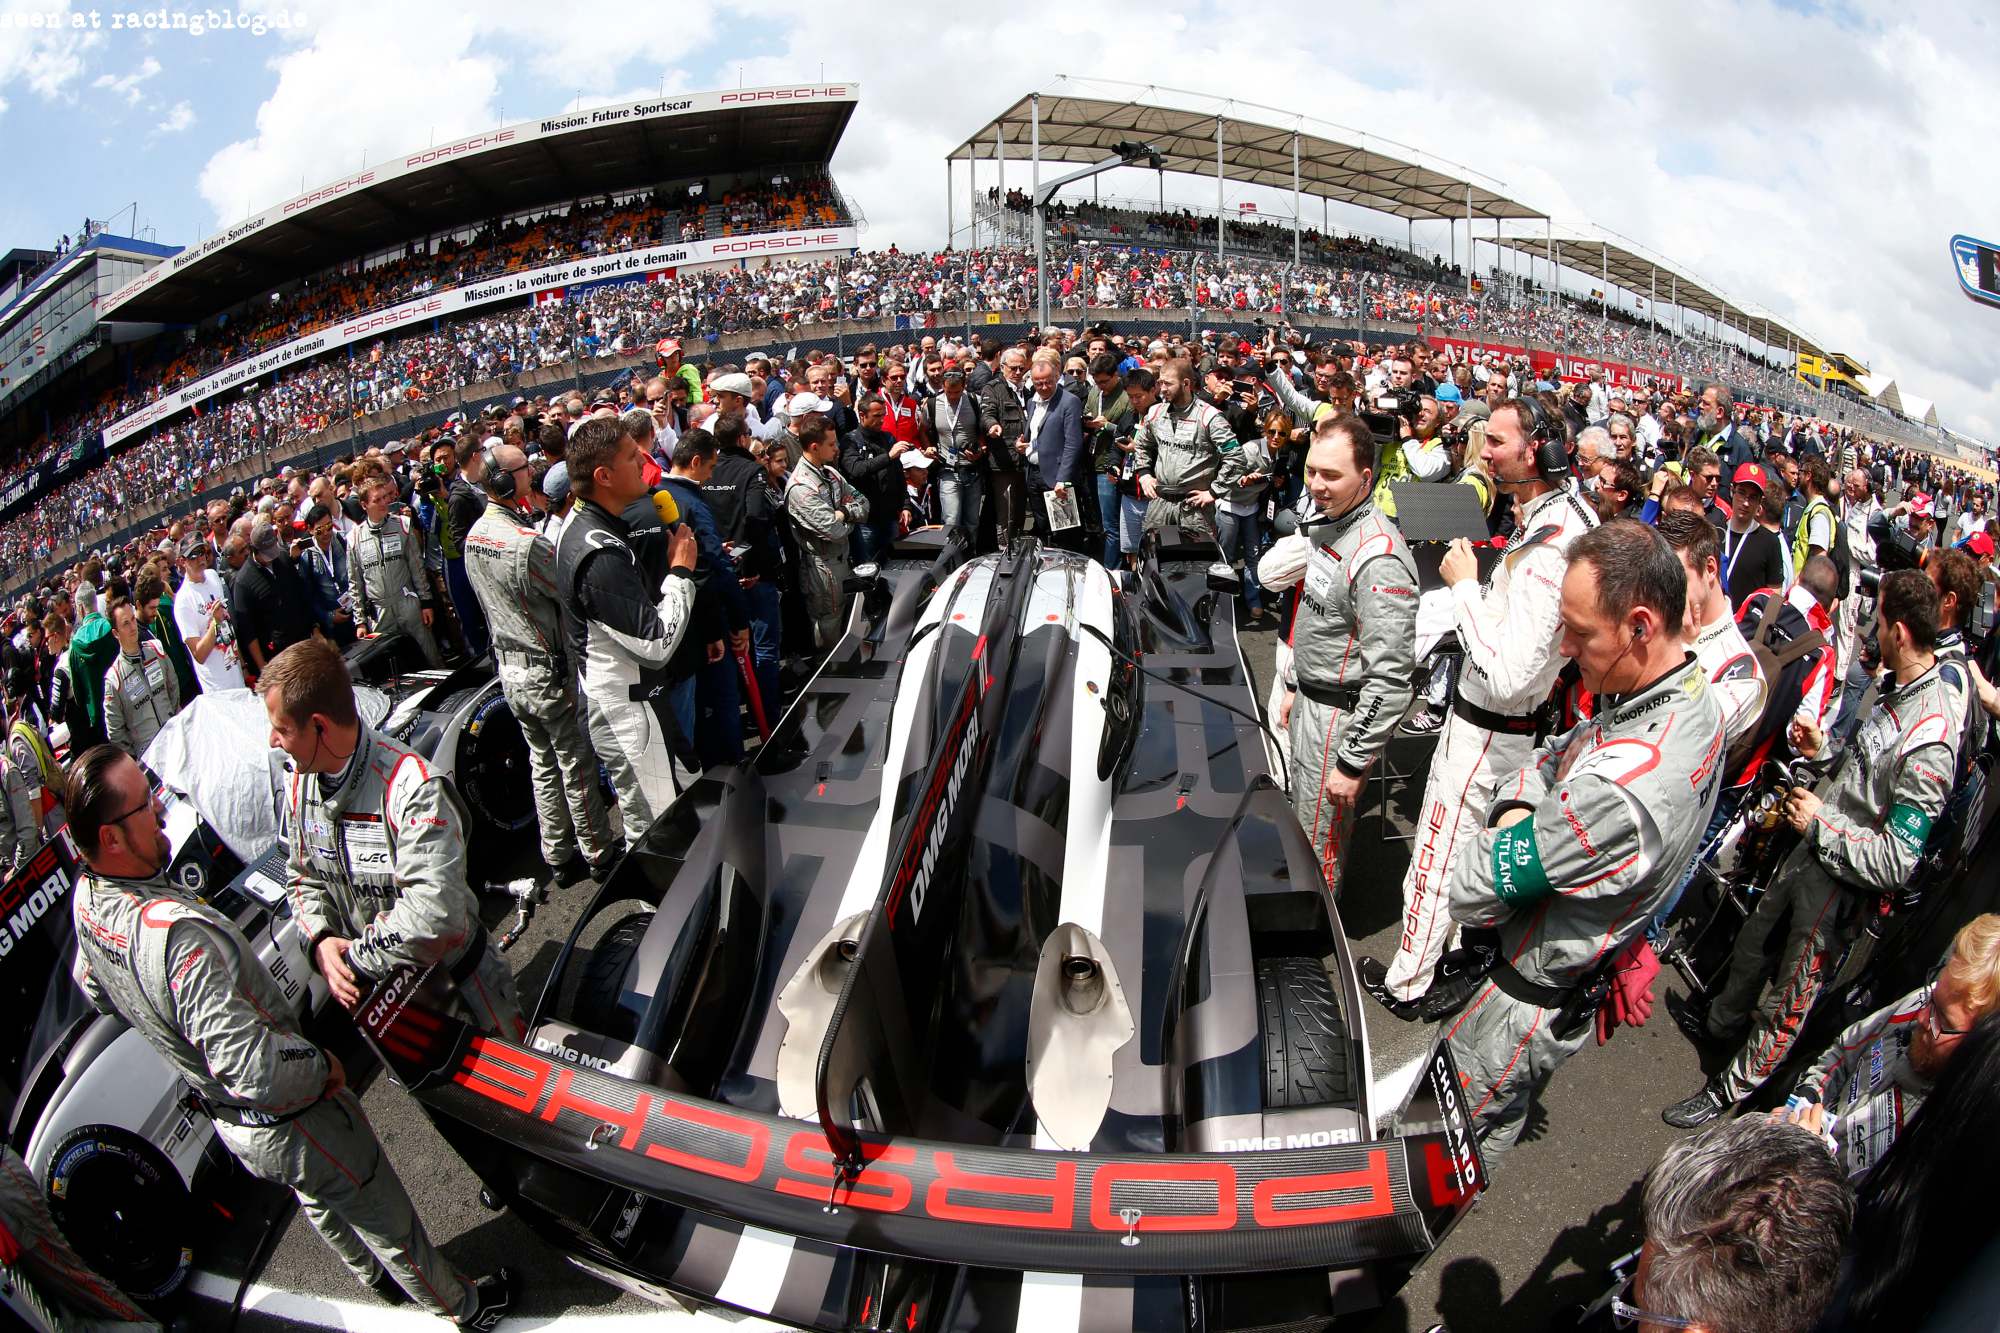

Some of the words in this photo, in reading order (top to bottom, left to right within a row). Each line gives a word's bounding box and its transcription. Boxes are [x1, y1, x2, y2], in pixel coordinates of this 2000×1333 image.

[720, 87, 847, 104] PORSCHE
[540, 116, 589, 133] Mission:
[592, 108, 631, 124] Future
[633, 99, 693, 118] Sportscar
[406, 129, 515, 168] PORSCHE
[283, 171, 375, 214] PORSCHE
[173, 249, 201, 269] Mission:
[203, 234, 226, 254] Future
[228, 217, 266, 240] Sportscar
[712, 233, 839, 254] PORSCHE
[101, 270, 160, 312] PORSCHE
[464, 286, 506, 303] Mission
[515, 278, 527, 291] la
[529, 270, 570, 288] voiture
[572, 267, 586, 278] de
[590, 262, 621, 277] sport
[625, 256, 640, 269] de
[643, 249, 687, 265] demain
[343, 300, 442, 337] PORSCHE
[180, 388, 206, 404] Mission
[211, 379, 220, 390] la
[220, 370, 246, 387] voiture
[247, 364, 258, 378] de
[258, 354, 280, 375] sport
[281, 348, 292, 361] de
[294, 337, 325, 357] demain
[1444, 343, 1513, 367] NISSA
[1555, 358, 1614, 384] NISSN
[1631, 370, 1674, 390] NISSAN
[111, 403, 168, 437] PORSCHE
[627, 526, 662, 538] SCHE
[1900, 679, 1936, 701] CHOPARD
[1363, 695, 1384, 730] MORI
[1613, 695, 1671, 725] CHOPARD
[394, 713, 424, 742] HOPARD
[885, 676, 977, 931] PORSCHE
[910, 798, 948, 926] DMG
[947, 706, 979, 815] MORI
[358, 853, 388, 863] WEC
[1402, 801, 1447, 953] PORSCHE
[9, 867, 71, 940] MORI
[416, 960, 439, 988] PARTN
[368, 966, 417, 1026] CHOPA
[534, 1037, 579, 1062] DMG
[453, 1036, 1394, 1230] PORSCHE
[1436, 1055, 1476, 1185] CHOPARD
[61, 1143, 95, 1171] MICHELIN
[1216, 1136, 1282, 1153] DMG
[1286, 1127, 1357, 1149] MORI
